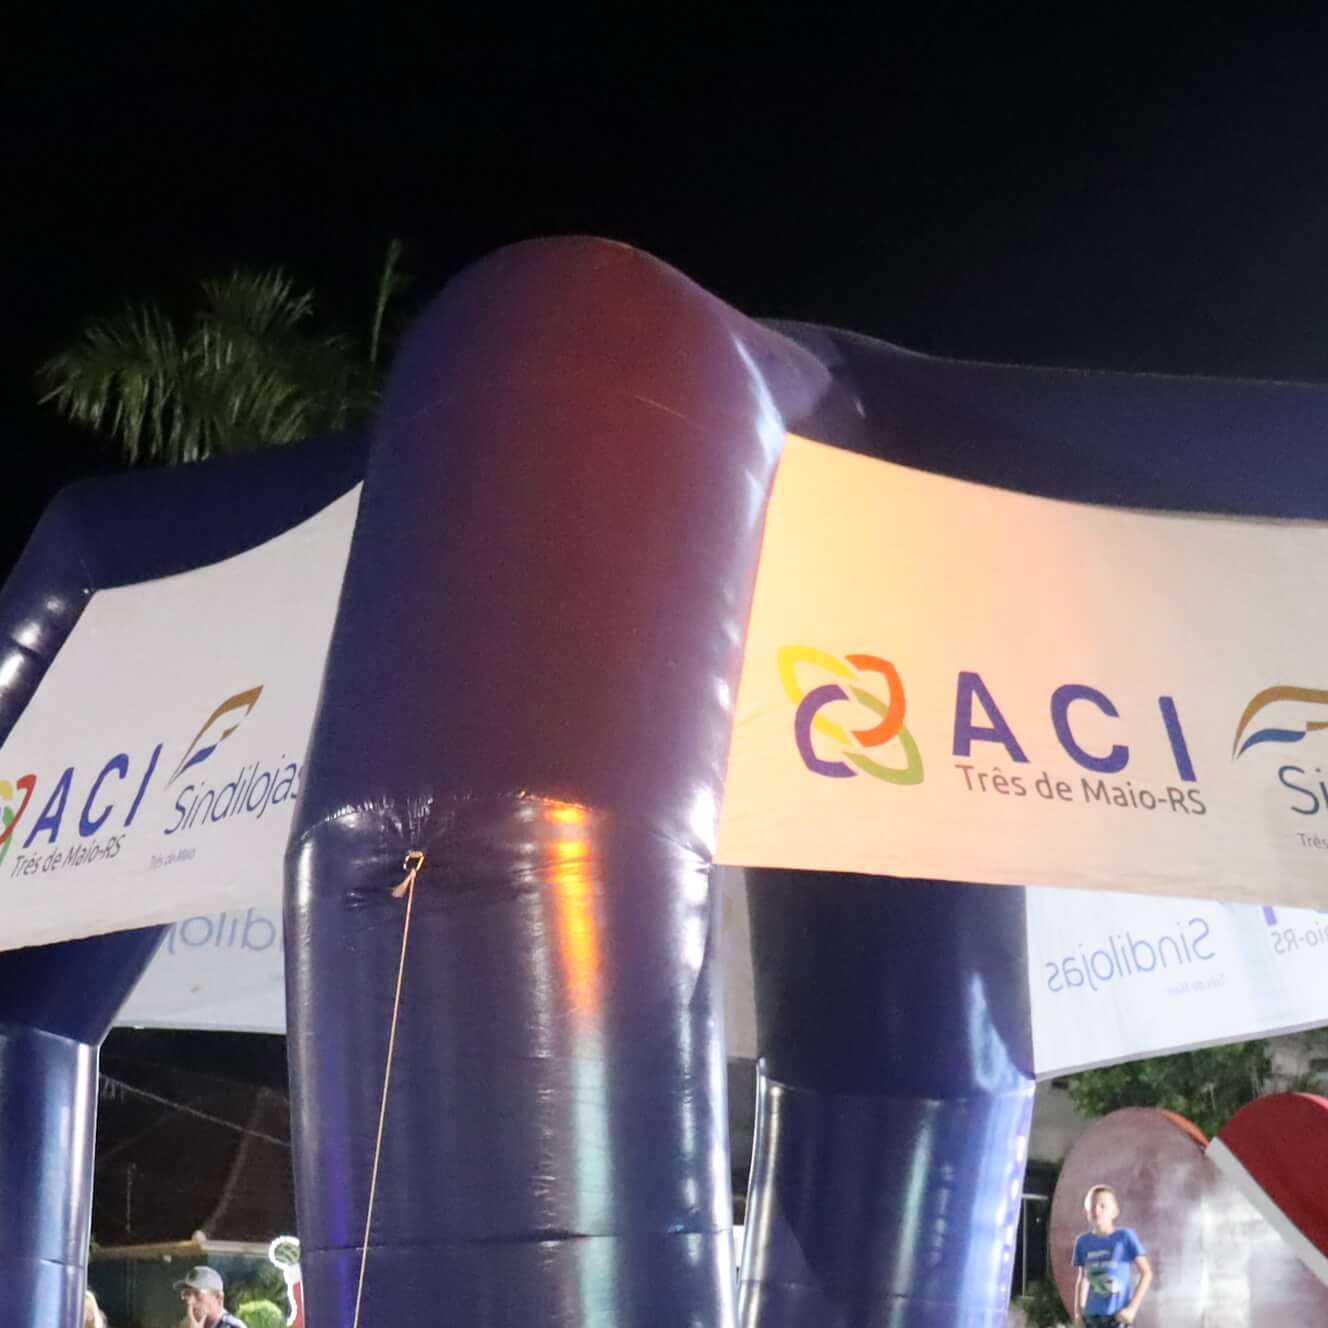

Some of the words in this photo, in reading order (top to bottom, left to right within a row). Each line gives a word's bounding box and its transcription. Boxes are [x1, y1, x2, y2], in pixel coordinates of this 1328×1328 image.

[952, 671, 1197, 783] ACI
[23, 744, 162, 848] ACI
[955, 763, 1027, 797] Três
[1035, 772, 1073, 801] de
[1081, 778, 1207, 816] Maio-RS
[42, 847, 65, 872] de
[1296, 832, 1328, 848] Três
